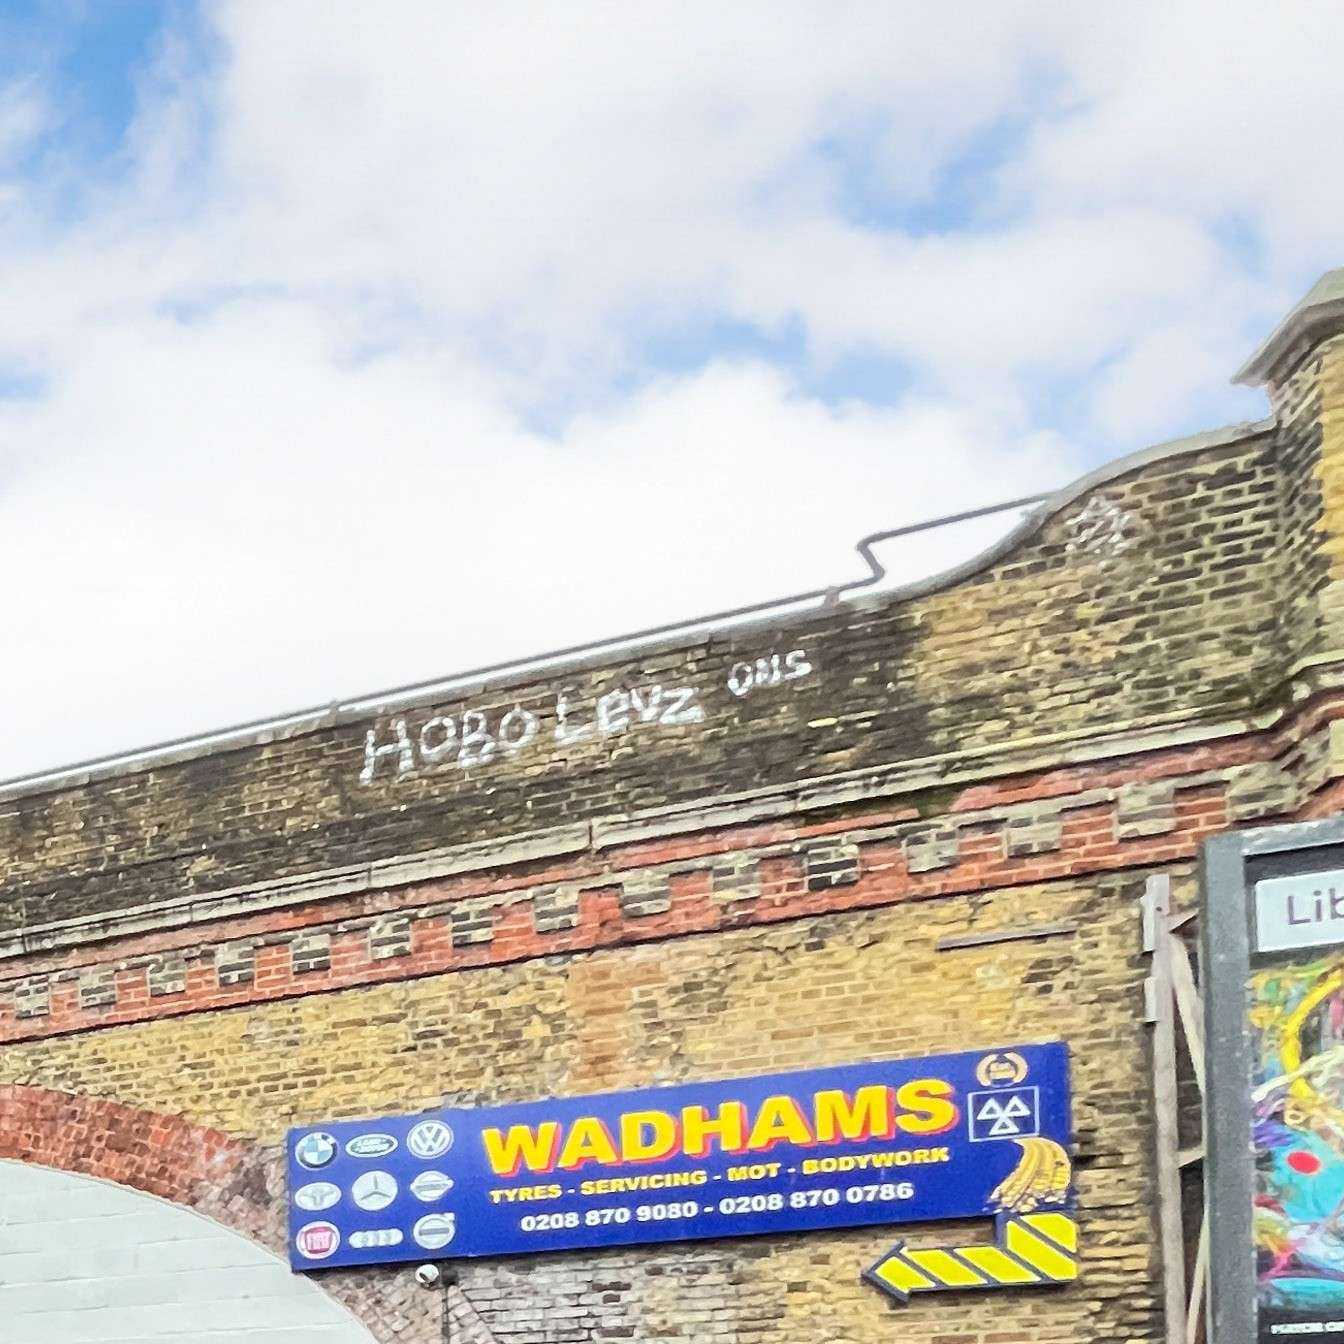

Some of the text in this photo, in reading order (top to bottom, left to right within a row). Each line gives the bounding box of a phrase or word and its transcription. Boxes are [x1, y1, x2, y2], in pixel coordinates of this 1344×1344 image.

[1288, 887, 1344, 925] Lib
[481, 1079, 958, 1177] WADHAMS
[489, 1184, 562, 1204] TYRES
[580, 1170, 708, 1196] SERVICING
[727, 1162, 782, 1182] MOT
[802, 1147, 950, 1175] BODYWORK
[520, 1212, 580, 1232] 0208
[585, 1207, 631, 1227] 870
[635, 1201, 699, 1222] 9080
[718, 1193, 784, 1215] 0208
[790, 1188, 841, 1209] 870
[845, 1182, 915, 1205] 0786
